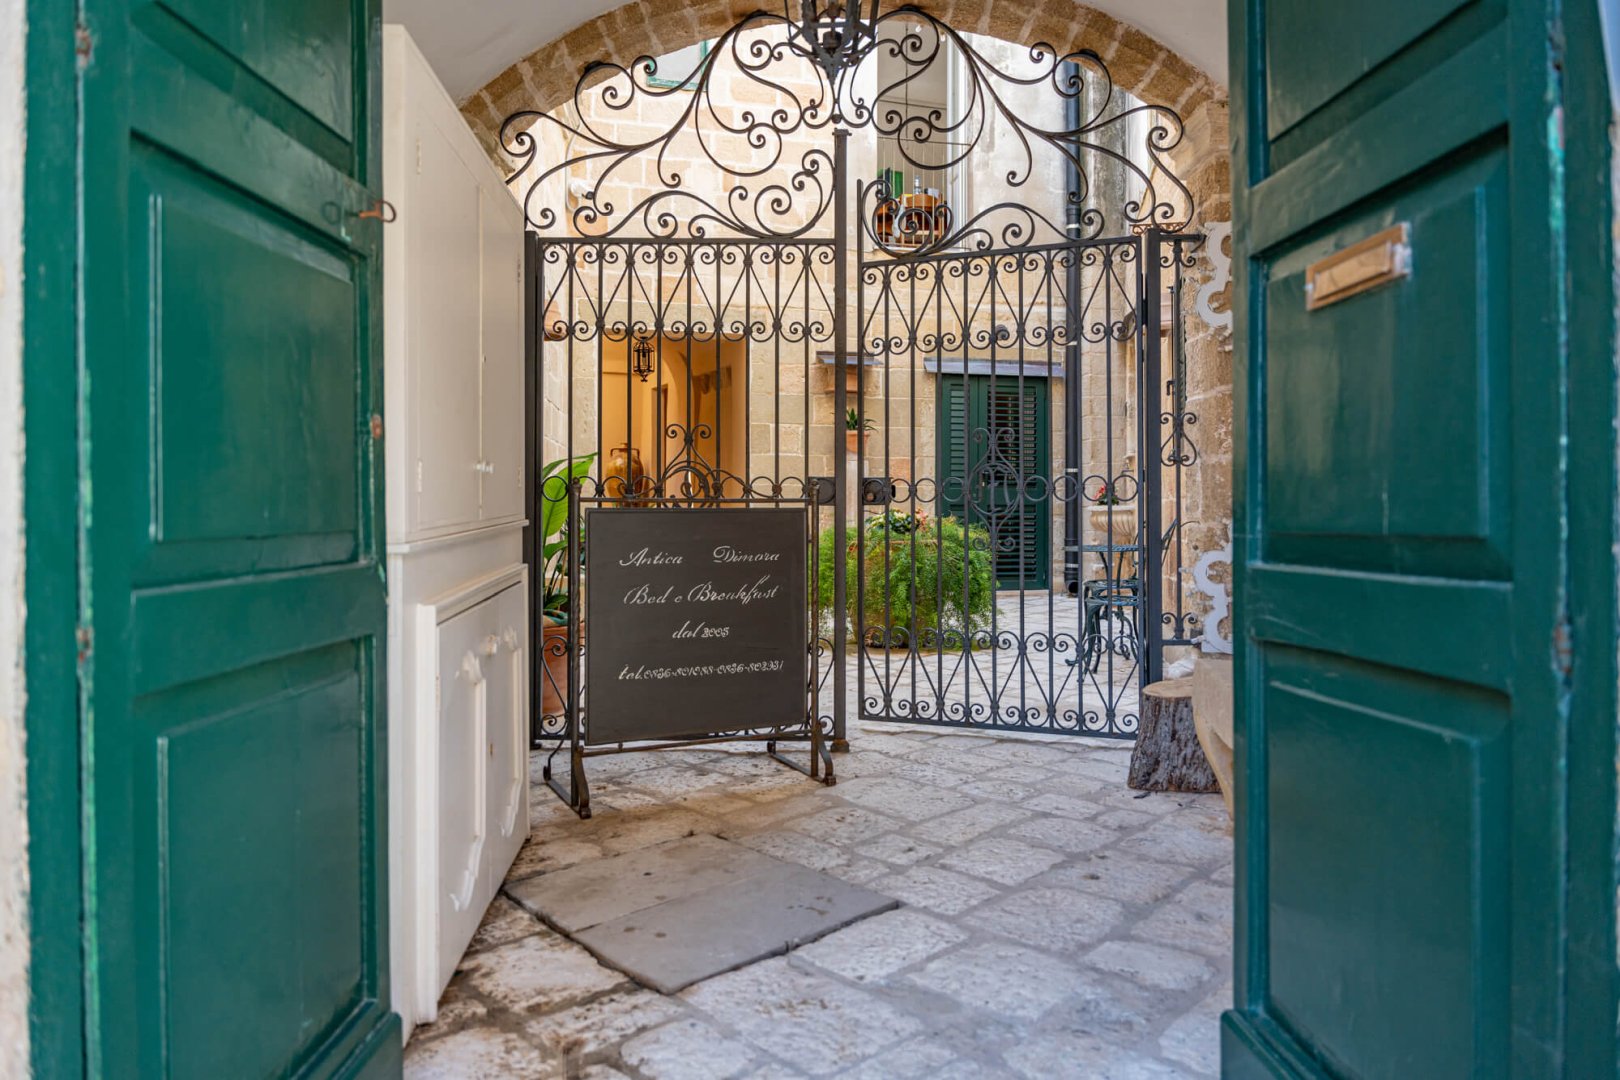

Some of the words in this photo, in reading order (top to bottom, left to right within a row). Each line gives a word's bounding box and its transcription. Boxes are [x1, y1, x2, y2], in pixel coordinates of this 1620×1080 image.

[619, 547, 683, 567] Antica
[713, 545, 780, 564] Dimora
[623, 584, 674, 605] Bed
[687, 574, 778, 605] Breakfast
[672, 620, 705, 639] dal
[701, 626, 730, 638] 2005
